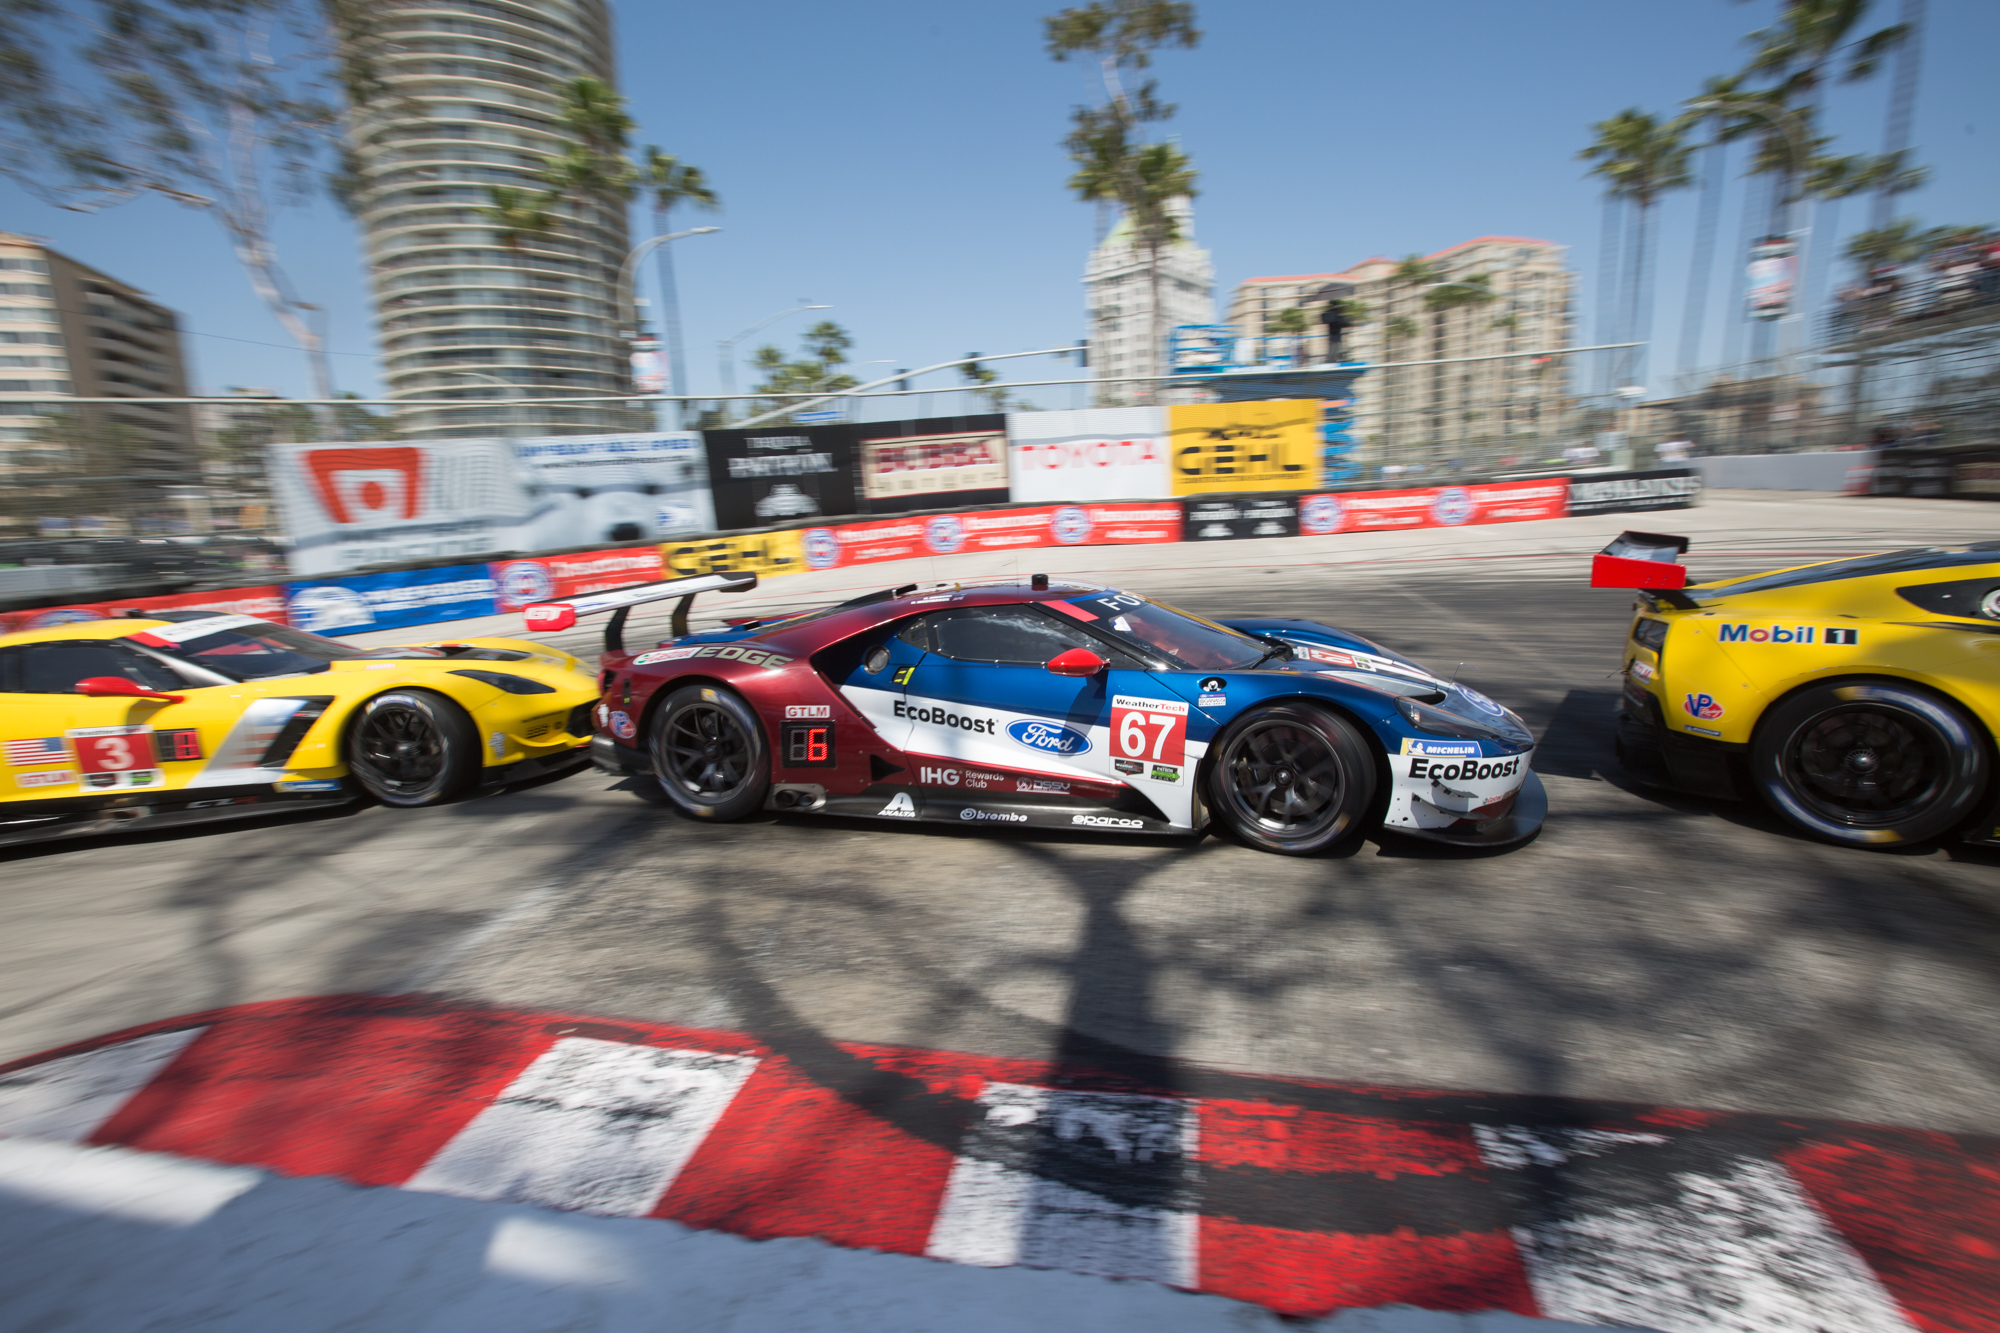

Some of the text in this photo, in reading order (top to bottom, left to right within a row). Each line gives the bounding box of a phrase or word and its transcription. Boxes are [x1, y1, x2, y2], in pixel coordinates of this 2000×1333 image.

[1015, 441, 1163, 470] TOYOTA
[1718, 624, 1814, 643] Mobil
[694, 646, 795, 671] EDGE
[788, 706, 827, 717] GTLM
[1116, 698, 1185, 712] WeatherTech
[1686, 692, 1713, 718] VP
[894, 700, 995, 735] EcoBoost
[808, 728, 827, 761] 6
[1021, 723, 1073, 752] Ford
[1120, 711, 1176, 760] 67
[94, 738, 135, 770] 3
[1426, 746, 1475, 754] MICHELIN
[920, 766, 960, 785] IHG
[965, 770, 1004, 781] Rewards
[1408, 756, 1519, 780] EcoBoost
[965, 779, 987, 789] Club
[877, 809, 915, 819] AXALTA
[976, 810, 1027, 822] brembo
[1072, 815, 1143, 829] sparco
